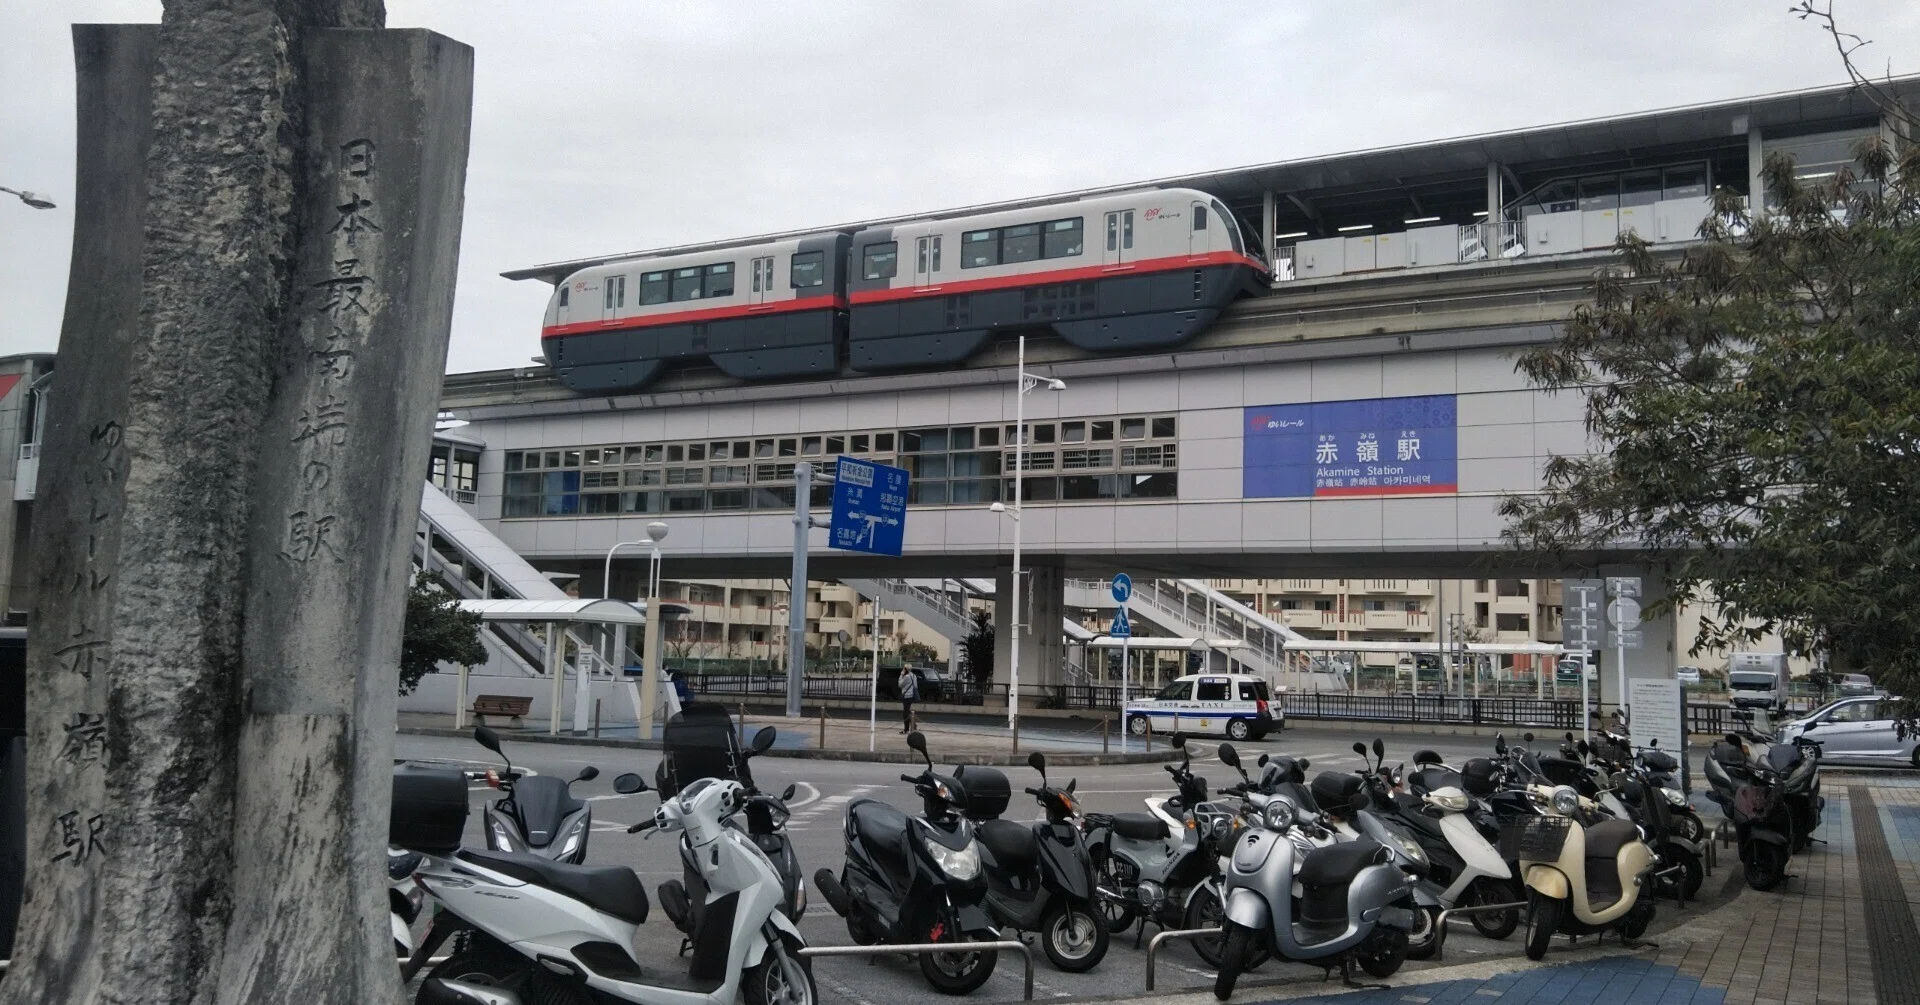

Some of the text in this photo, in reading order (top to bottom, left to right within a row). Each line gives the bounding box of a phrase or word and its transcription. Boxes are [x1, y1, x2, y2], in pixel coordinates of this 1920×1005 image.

[275, 138, 384, 566] 日本最南端の駅
[1267, 419, 1305, 429] ゆいレール
[1316, 465, 1404, 477] Akamine Station
[1383, 474, 1431, 486] 아카미네역
[1162, 852, 1180, 875] HONDA
